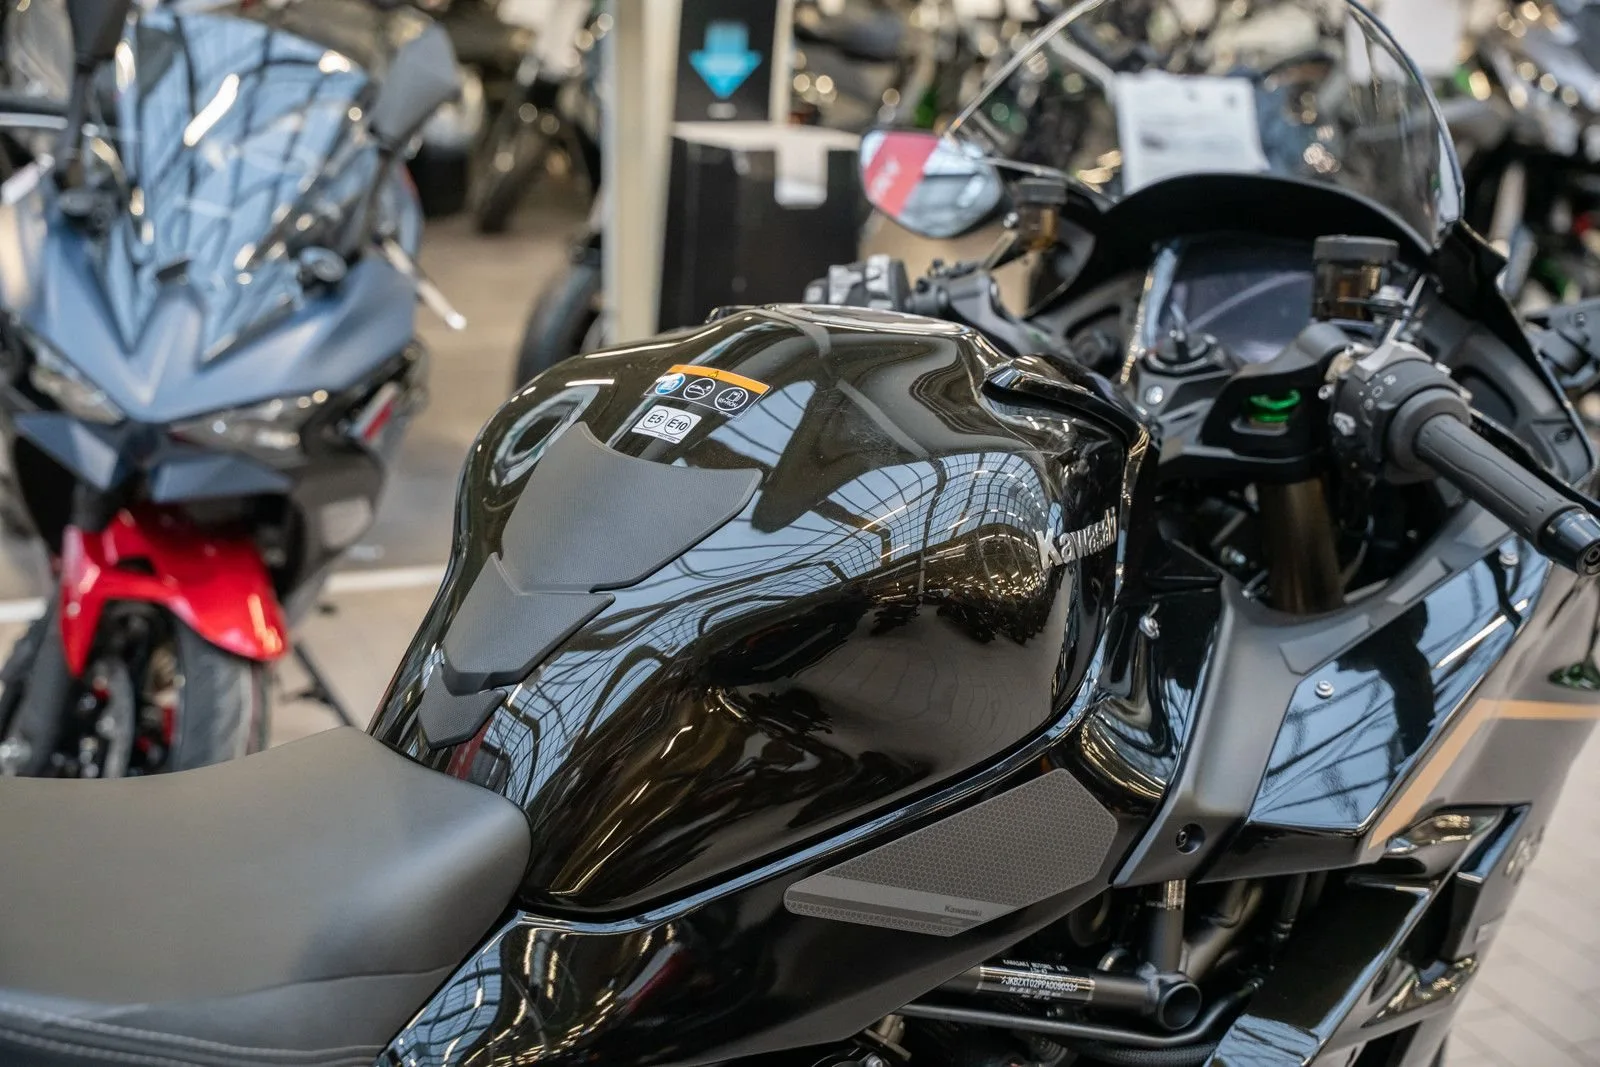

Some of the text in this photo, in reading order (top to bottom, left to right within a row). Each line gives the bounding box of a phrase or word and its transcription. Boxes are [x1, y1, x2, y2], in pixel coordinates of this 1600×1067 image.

[647, 412, 688, 431] E5 E10
[944, 904, 982, 917] Kawasaki
